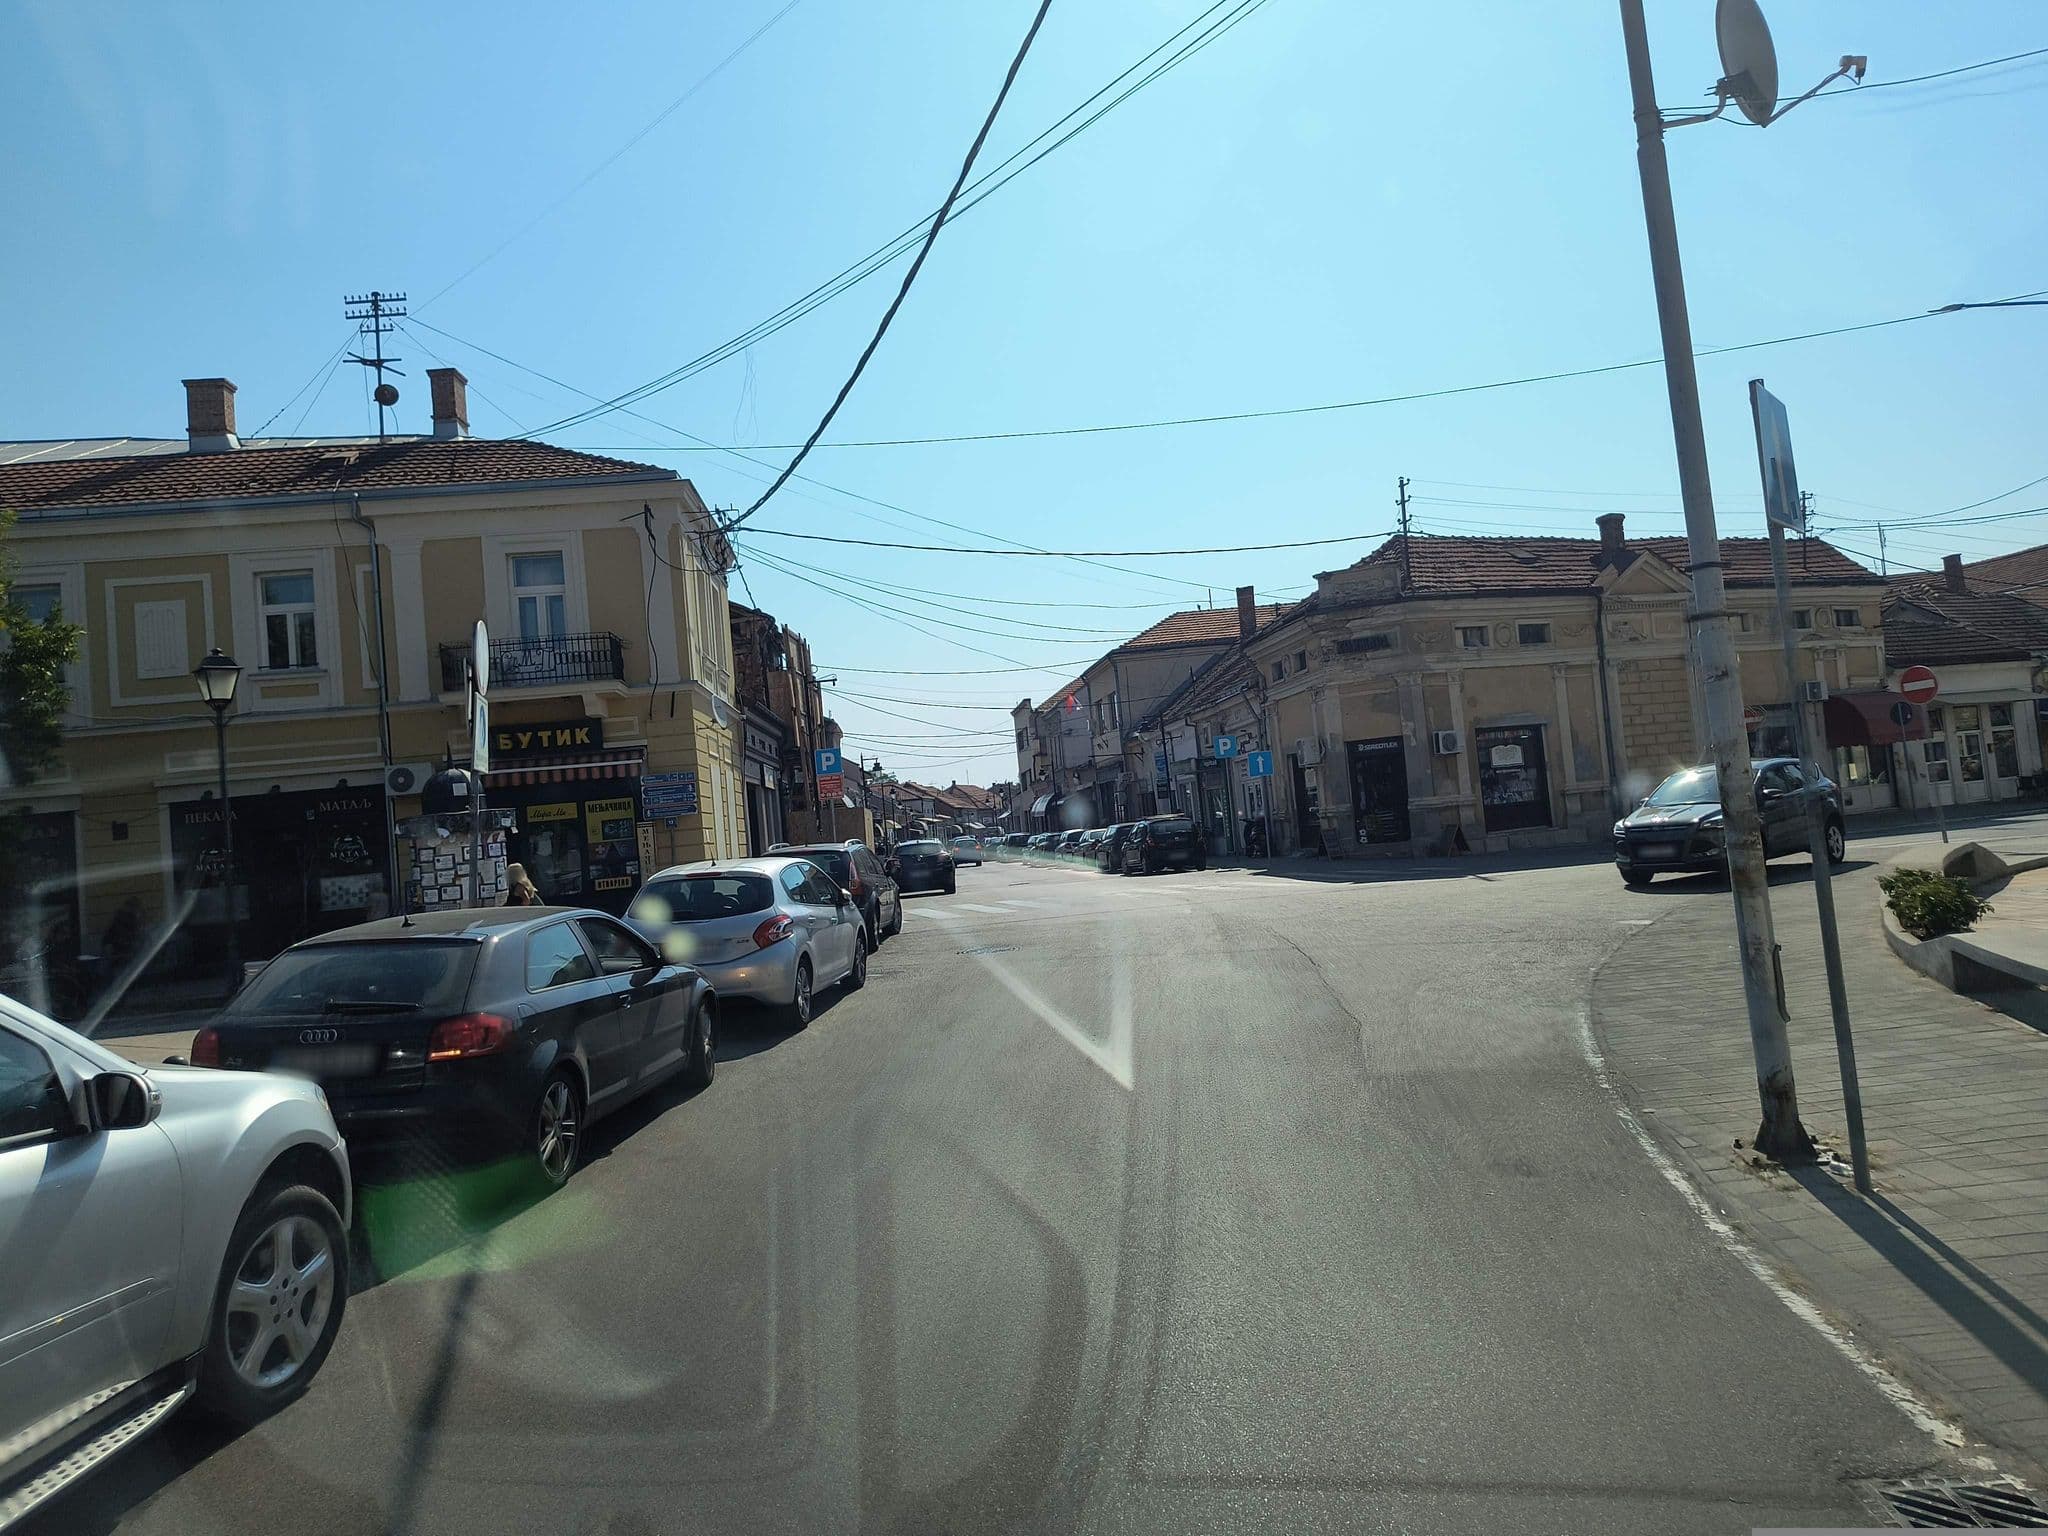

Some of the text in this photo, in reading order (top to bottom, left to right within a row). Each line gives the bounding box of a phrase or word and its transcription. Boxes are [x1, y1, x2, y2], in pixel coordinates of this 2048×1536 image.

[498, 728, 591, 750] БУТИК
[1218, 738, 1232, 755] P
[821, 752, 835, 771] P
[319, 798, 372, 812] МАТАЉ
[587, 801, 632, 813] МЕЊАЧНИЦА
